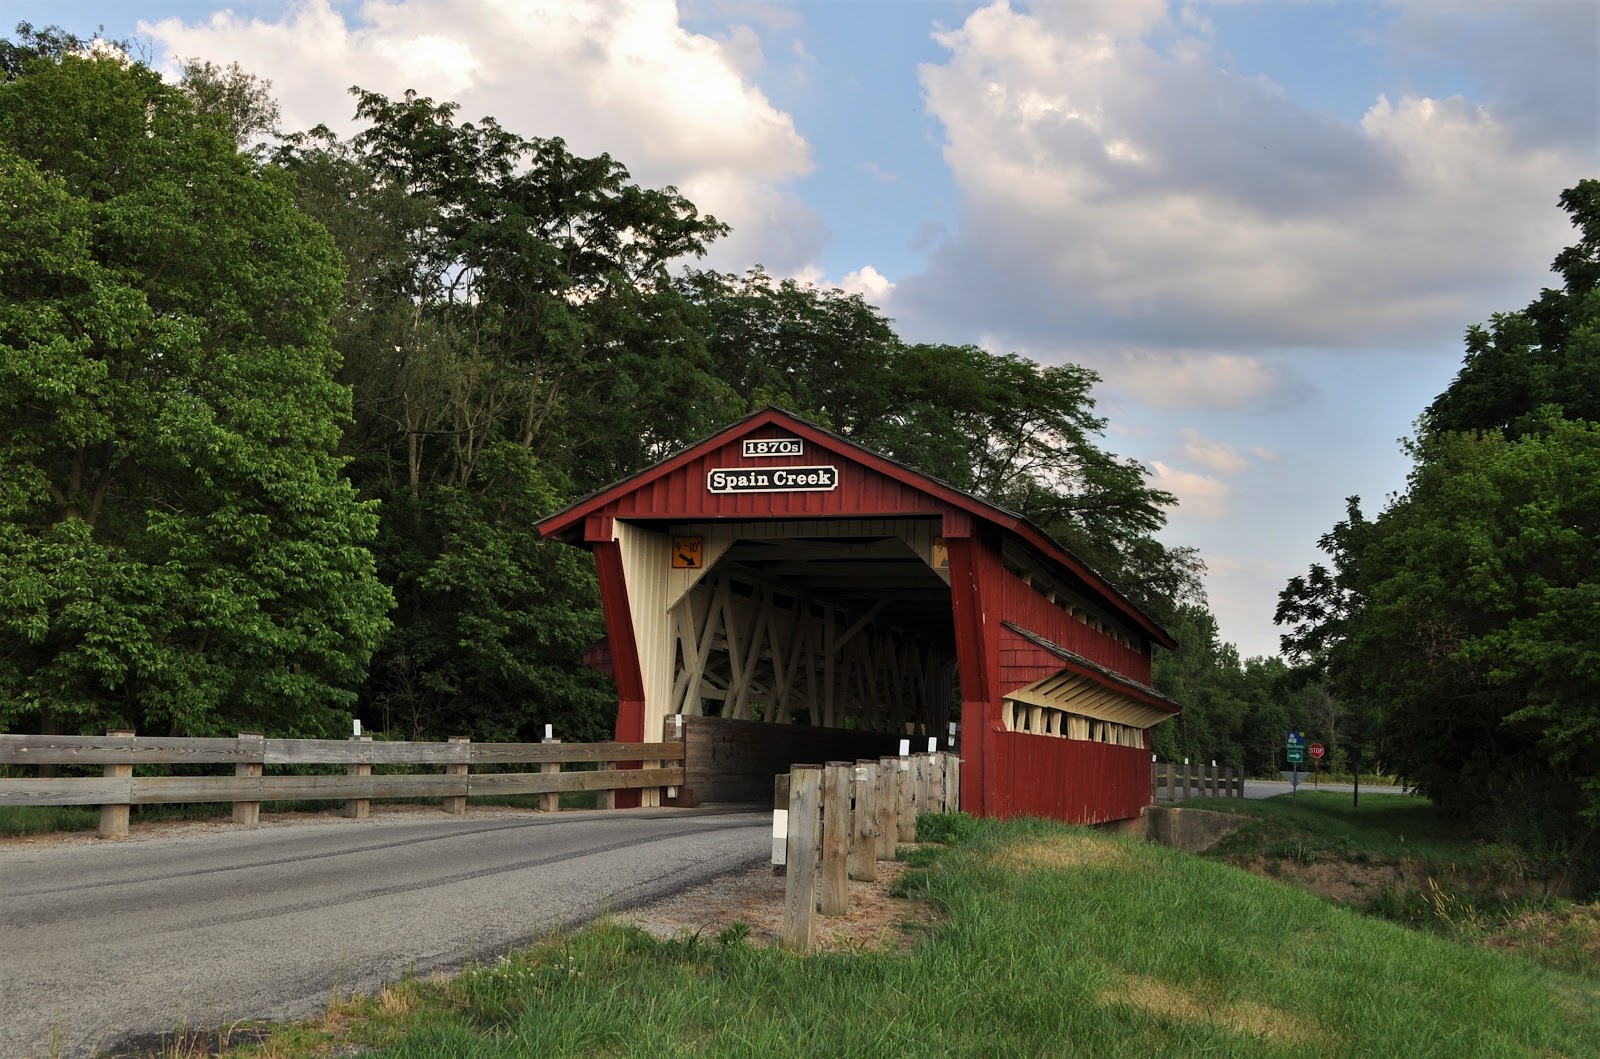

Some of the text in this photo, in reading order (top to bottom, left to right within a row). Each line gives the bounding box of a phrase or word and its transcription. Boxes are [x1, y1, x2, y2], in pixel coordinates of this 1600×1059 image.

[747, 441, 799, 454] 1870s
[713, 470, 831, 491] Spain Creek
